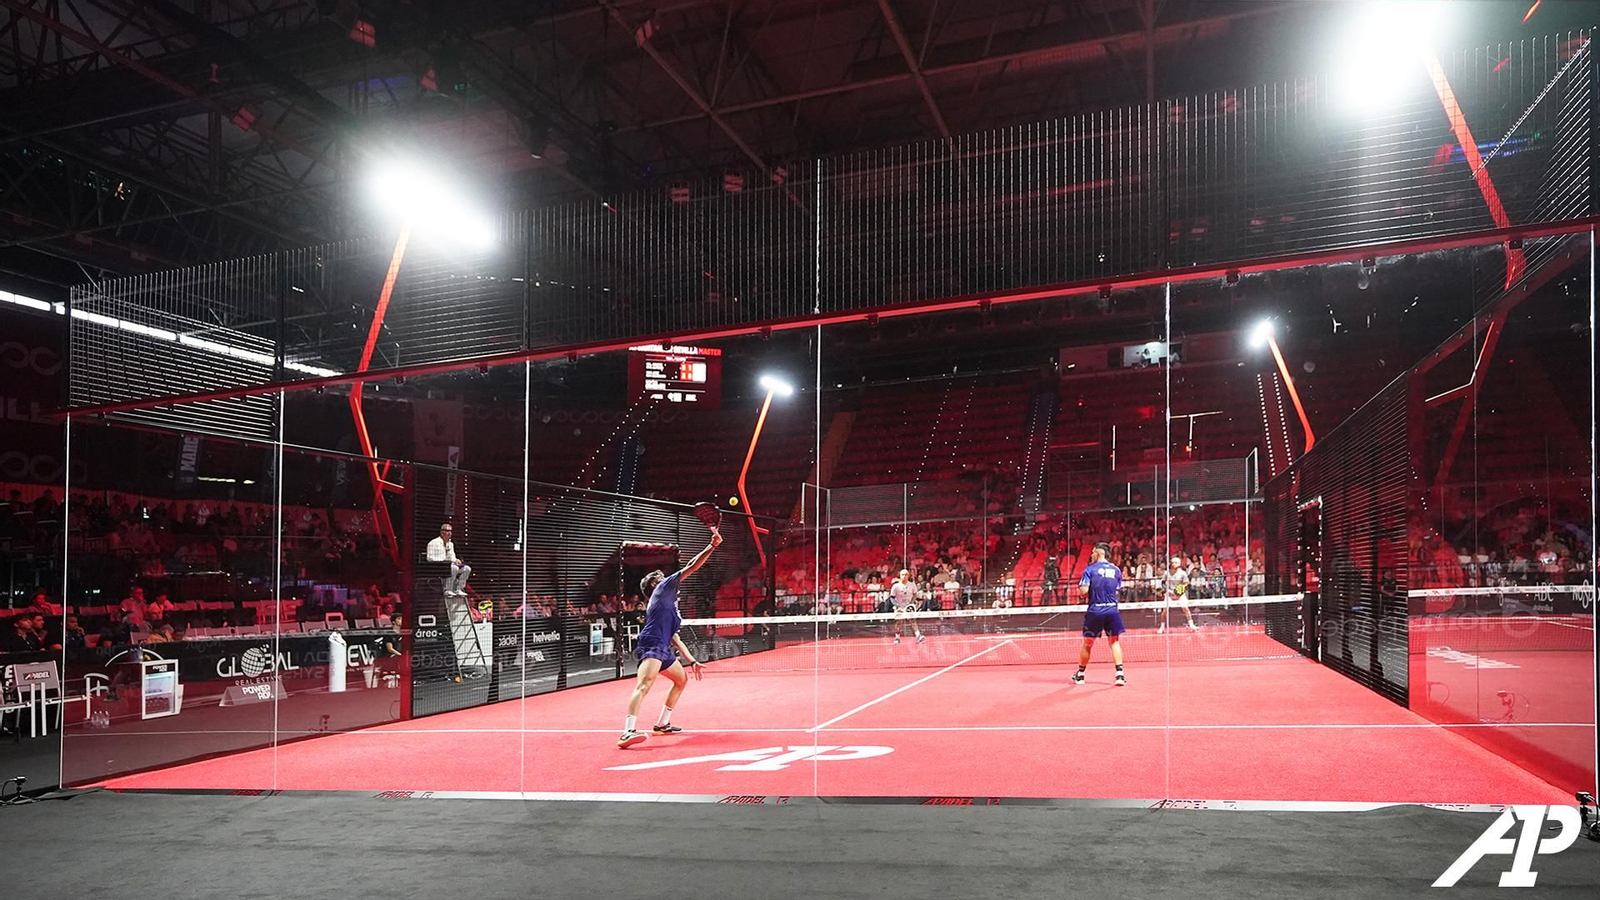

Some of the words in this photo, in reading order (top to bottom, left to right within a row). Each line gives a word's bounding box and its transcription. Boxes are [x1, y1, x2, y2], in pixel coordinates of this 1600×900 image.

[698, 347, 722, 356] MASTER
[533, 630, 561, 643] helvetia
[258, 675, 283, 684] ESTAE
[242, 685, 270, 695] POWER
